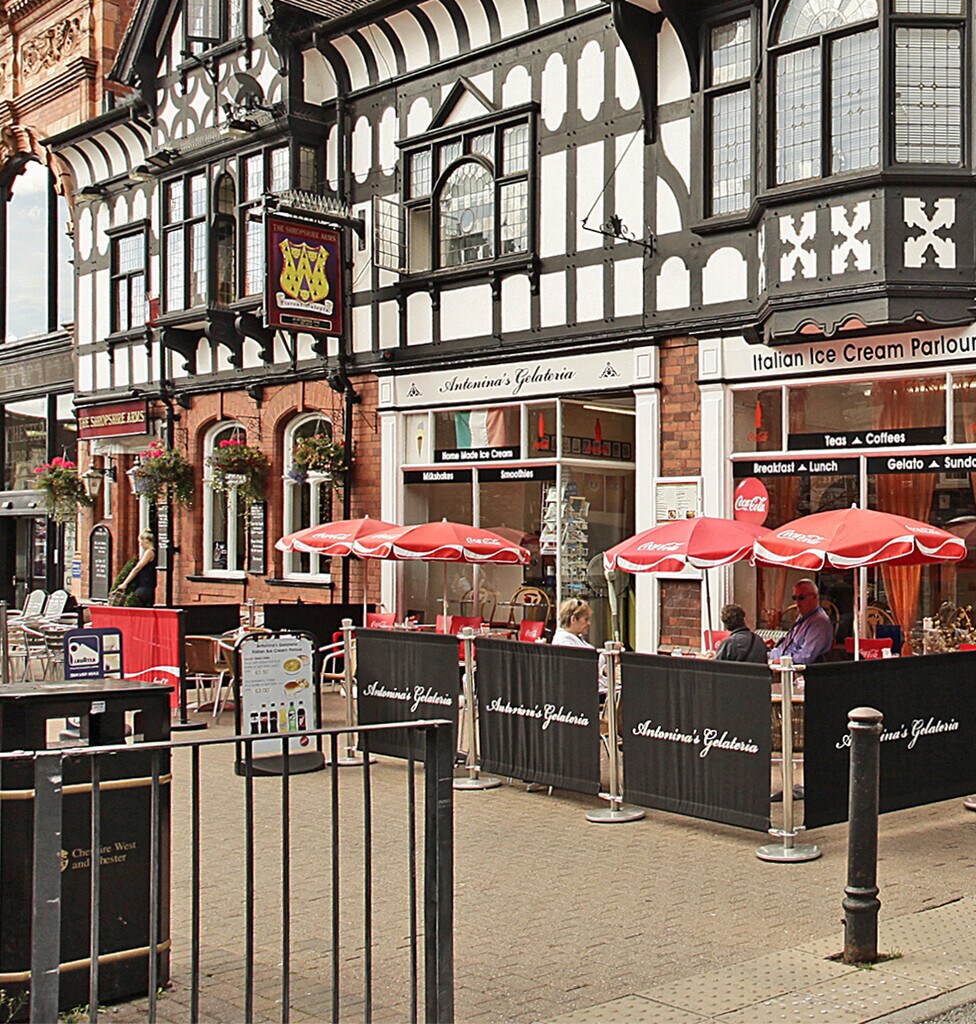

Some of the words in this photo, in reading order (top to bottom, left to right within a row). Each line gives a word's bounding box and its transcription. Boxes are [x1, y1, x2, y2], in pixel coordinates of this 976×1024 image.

[753, 351, 804, 371] Italian
[810, 347, 837, 365] Ice
[843, 342, 905, 363] Cream
[439, 373, 511, 393] Antonina's
[512, 365, 577, 395] Gelateria
[78, 417, 90, 430] THE
[824, 435, 847, 446] Teas
[865, 432, 906, 445] Coffees
[442, 451, 460, 460] Home
[460, 450, 479, 460] Made
[479, 450, 490, 459] Ice
[491, 449, 513, 459] Cream
[753, 461, 795, 474] Breakfast
[809, 460, 838, 473] Lunch
[887, 457, 924, 470] Gelato
[423, 471, 454, 481] Milkshakes
[500, 469, 534, 479] Smoothies
[735, 495, 767, 513] Coca-Cola
[363, 681, 411, 700] Antonina's
[411, 685, 453, 712] Gelateria
[542, 704, 589, 729] Gelateria
[632, 720, 701, 744] Antonina's
[700, 728, 759, 758] Gelateria
[836, 724, 908, 749] Aina's
[907, 717, 959, 750] Gelateria
[72, 845, 111, 858] Cheire
[114, 842, 137, 851] West
[72, 858, 90, 869] and
